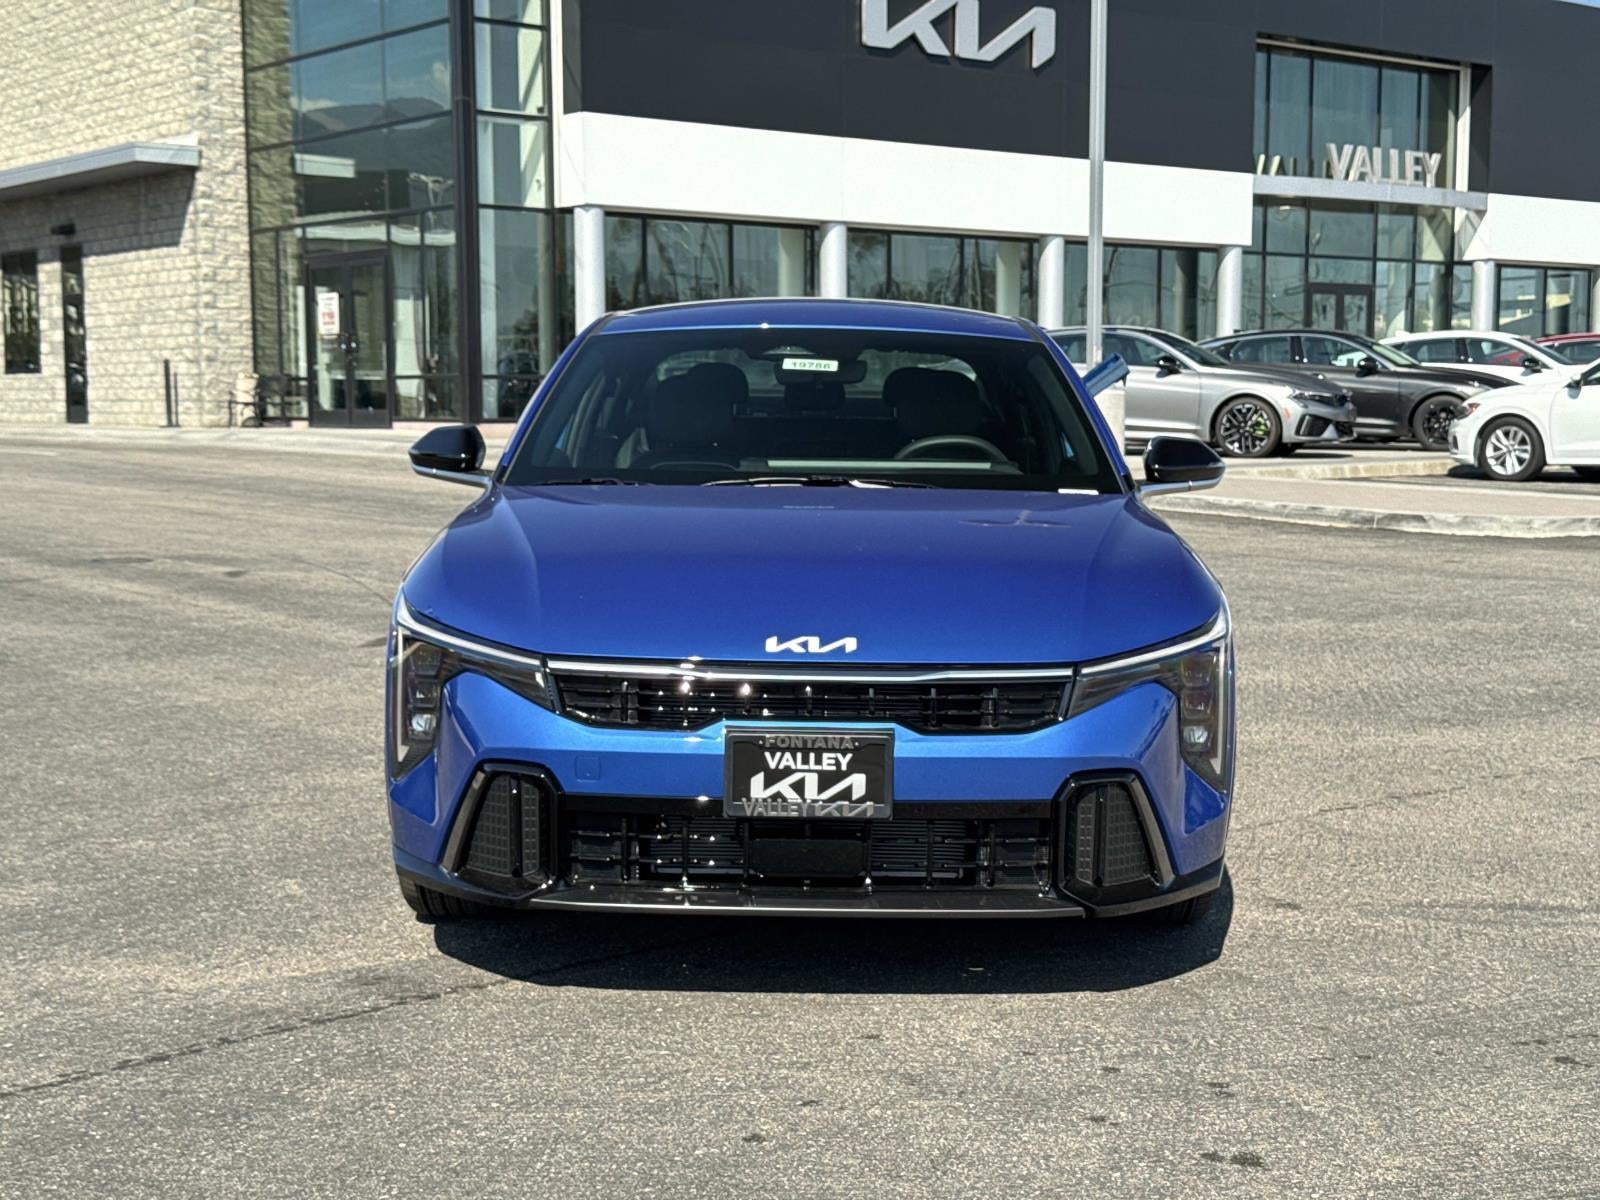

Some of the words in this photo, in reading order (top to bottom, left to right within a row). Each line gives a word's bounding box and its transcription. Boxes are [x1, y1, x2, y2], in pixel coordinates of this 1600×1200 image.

[861, 0, 1057, 69] KIA
[1326, 142, 1441, 188] VALLEY
[765, 635, 857, 653] KIA
[764, 734, 854, 750] FONTANA
[764, 751, 853, 771] VALLEY
[750, 771, 867, 801] KIA
[742, 797, 812, 817] VALLEY
